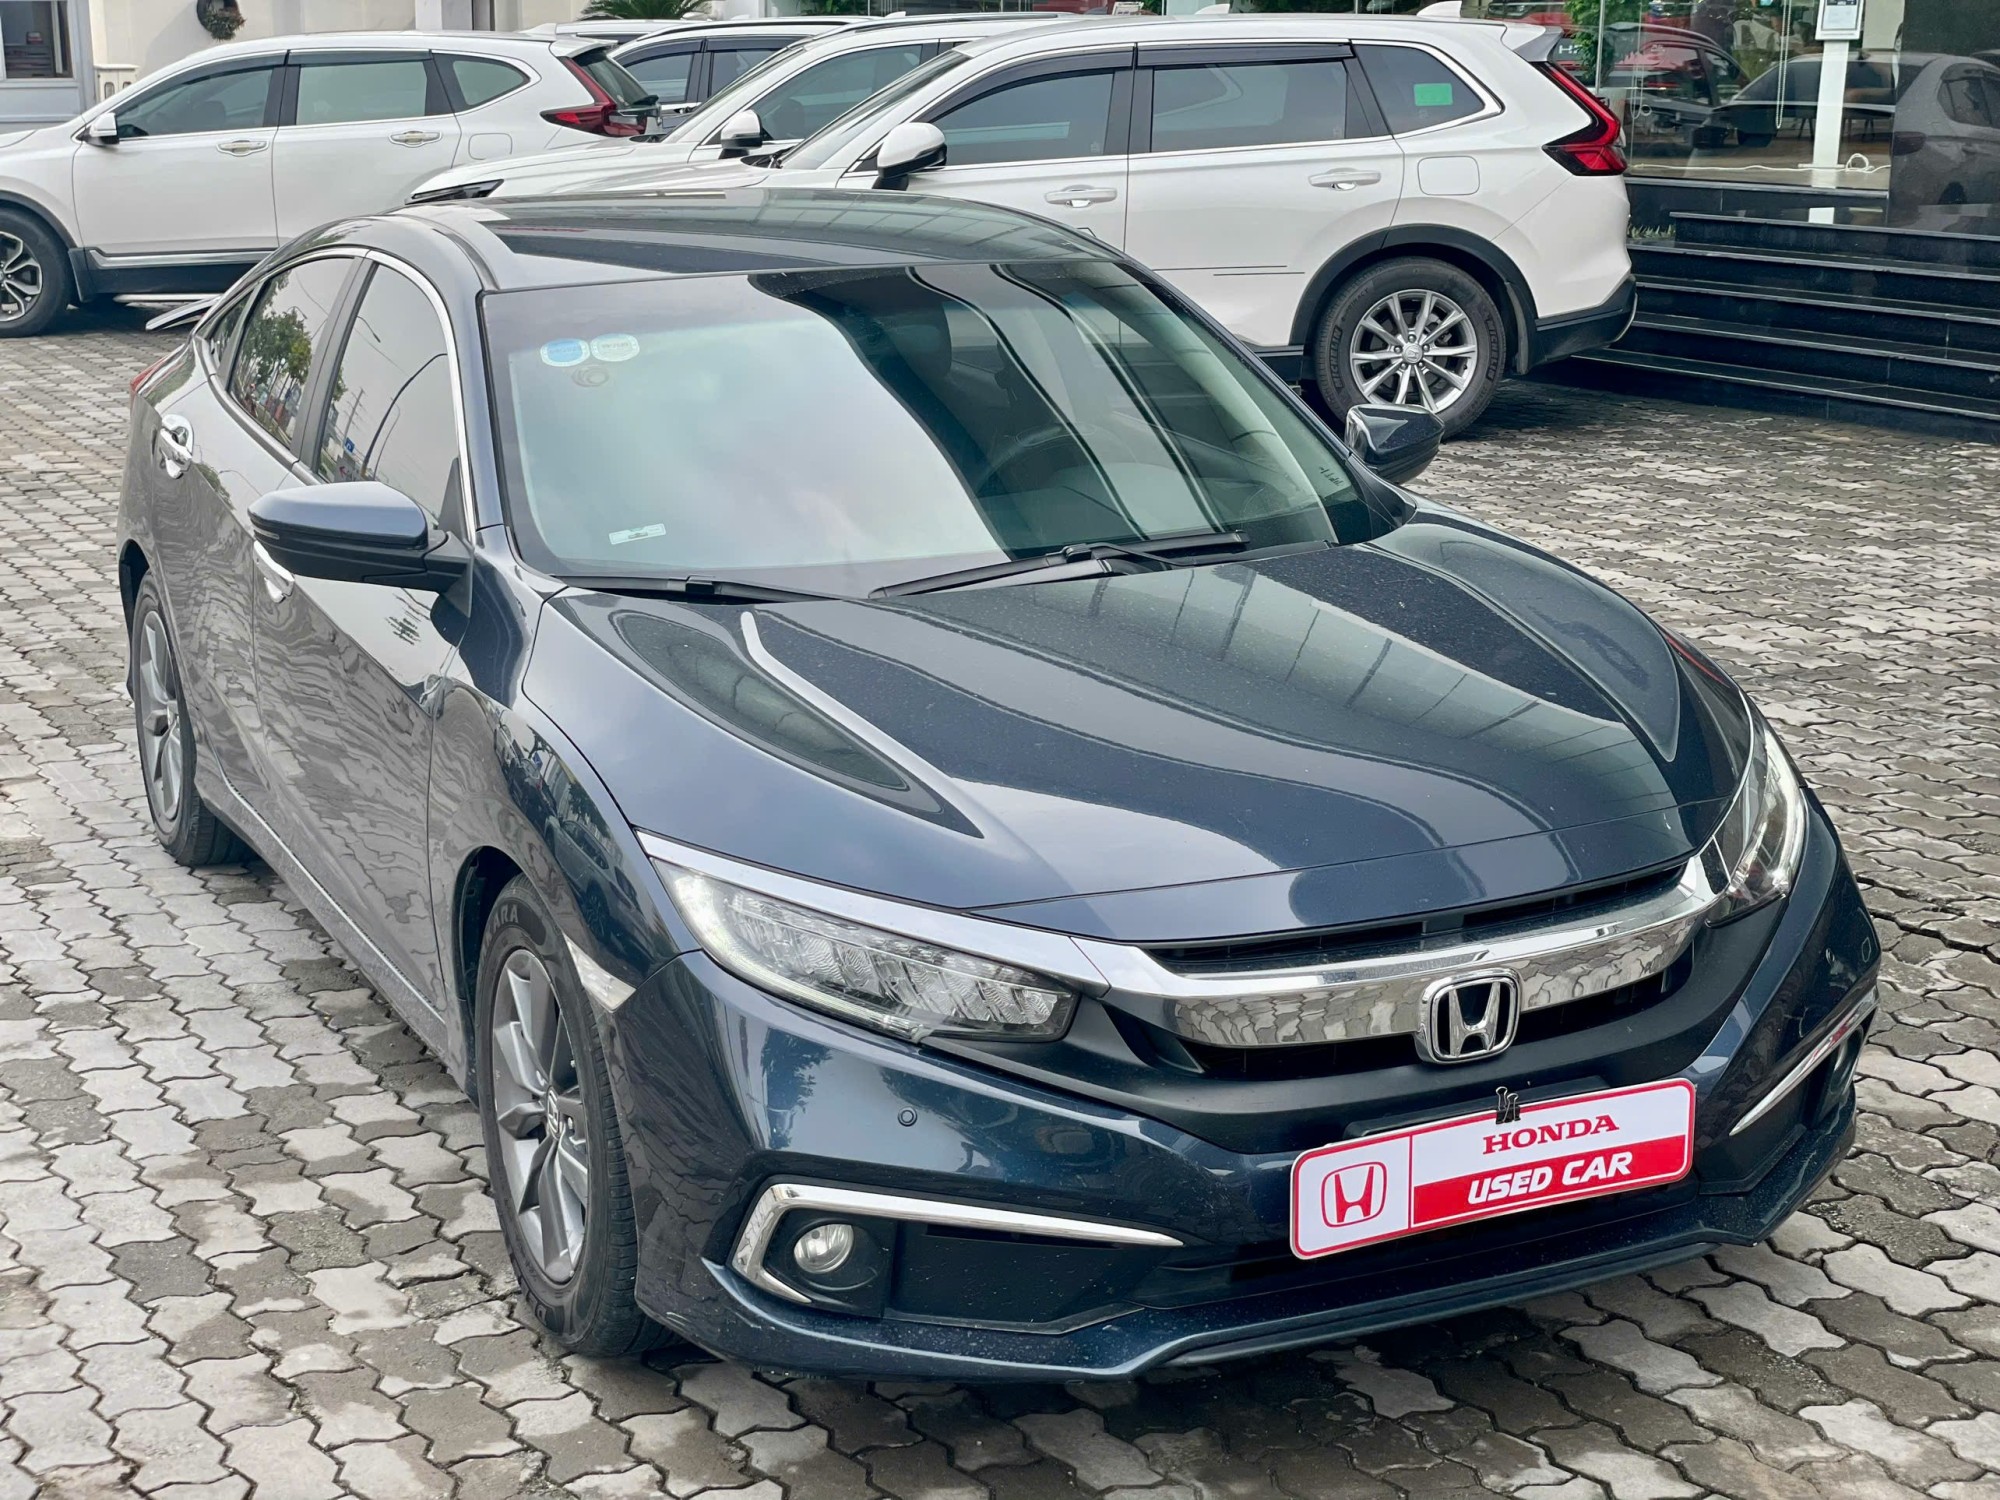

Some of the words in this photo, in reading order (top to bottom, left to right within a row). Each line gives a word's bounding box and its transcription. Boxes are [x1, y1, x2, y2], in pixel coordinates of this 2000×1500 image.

[1330, 325, 1343, 388] MICHELIN
[1485, 319, 1499, 379] MICHELIN
[1483, 1114, 1619, 1154] HONDA
[1468, 1166, 1553, 1204] USED
[1562, 1151, 1633, 1186] CAR
